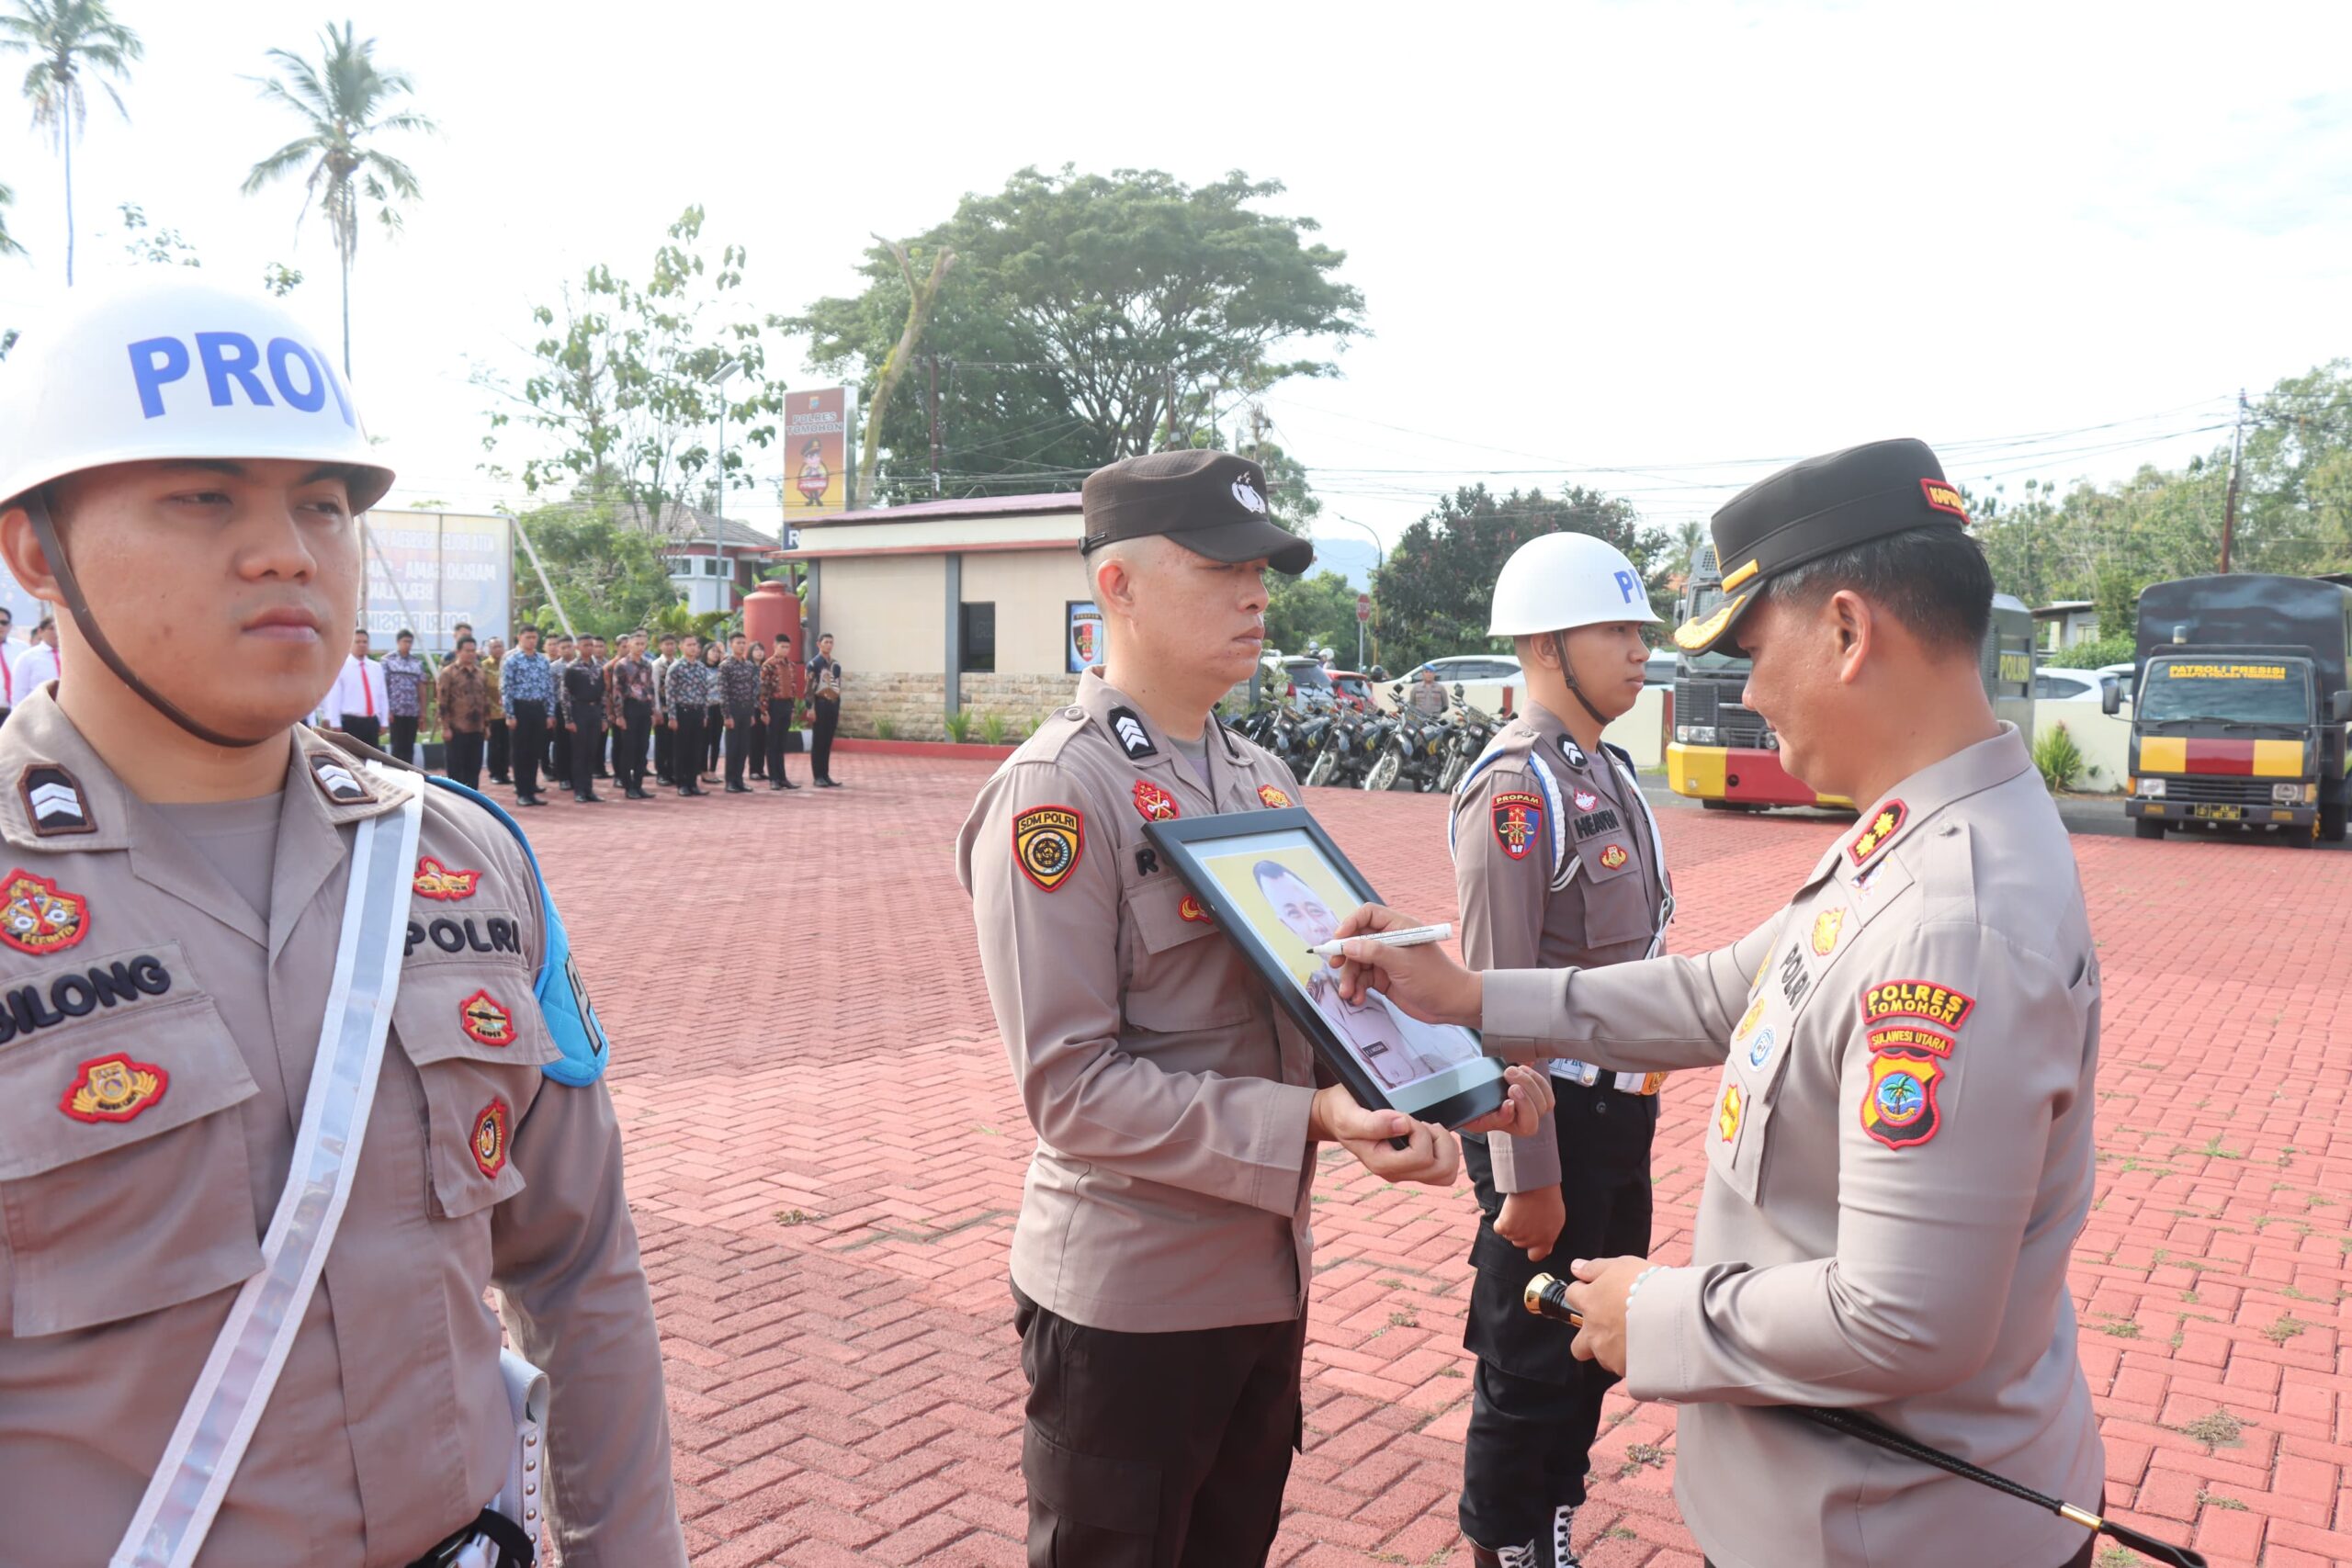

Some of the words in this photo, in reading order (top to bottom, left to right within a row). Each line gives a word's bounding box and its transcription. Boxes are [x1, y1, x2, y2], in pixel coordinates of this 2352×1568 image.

[786, 422, 843, 434] TOMOHON
[793, 412, 837, 424] POLRES
[2169, 665, 2227, 674] PATROLI
[2230, 665, 2286, 675] PRESISI
[1496, 794, 1539, 805] PROPAM
[1020, 814, 1042, 831] SDM
[1043, 812, 1075, 828] POLRI
[402, 918, 521, 956] POLRI
[1779, 942, 1812, 1012] POLRI
[1868, 983, 1963, 1013] POLRES
[1869, 999, 1956, 1023] TOMOHON
[1871, 1030, 1913, 1046] SULAWESI
[1915, 1032, 1947, 1052] UTARA
